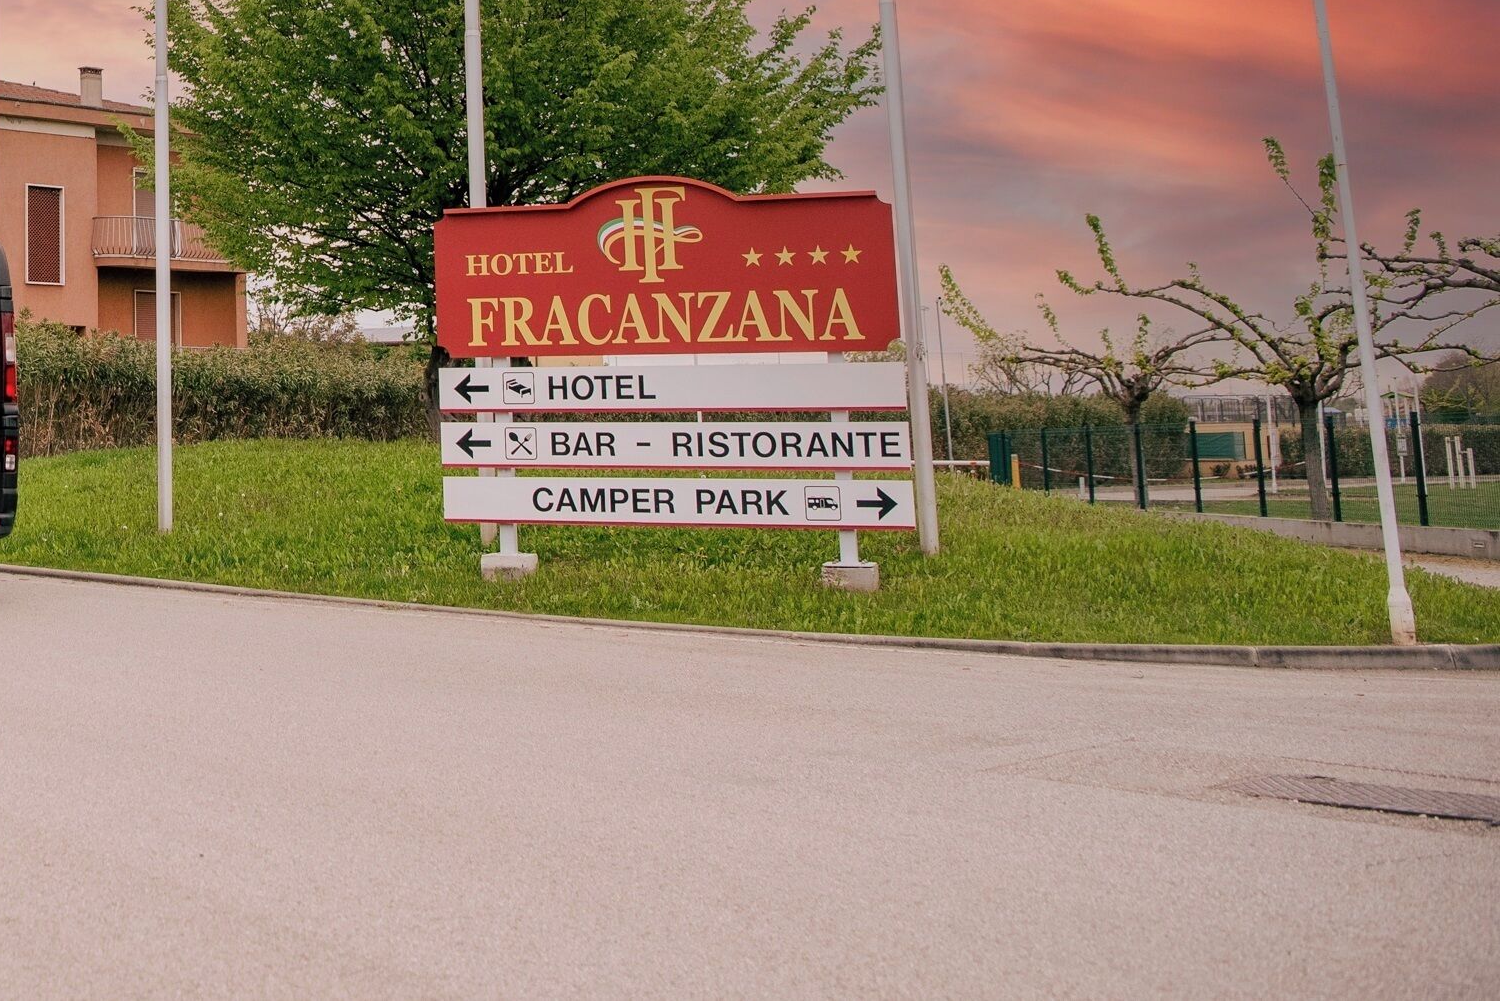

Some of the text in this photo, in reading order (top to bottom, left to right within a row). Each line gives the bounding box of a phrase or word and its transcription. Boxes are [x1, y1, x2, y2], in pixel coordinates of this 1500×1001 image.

[465, 251, 574, 277] HOTEL
[466, 287, 866, 347] FRACANZANA
[547, 374, 657, 401] HOTEL
[550, 431, 617, 457] BAR
[671, 431, 902, 459] RISTORANTE
[532, 486, 790, 516] CAMPER PARK
